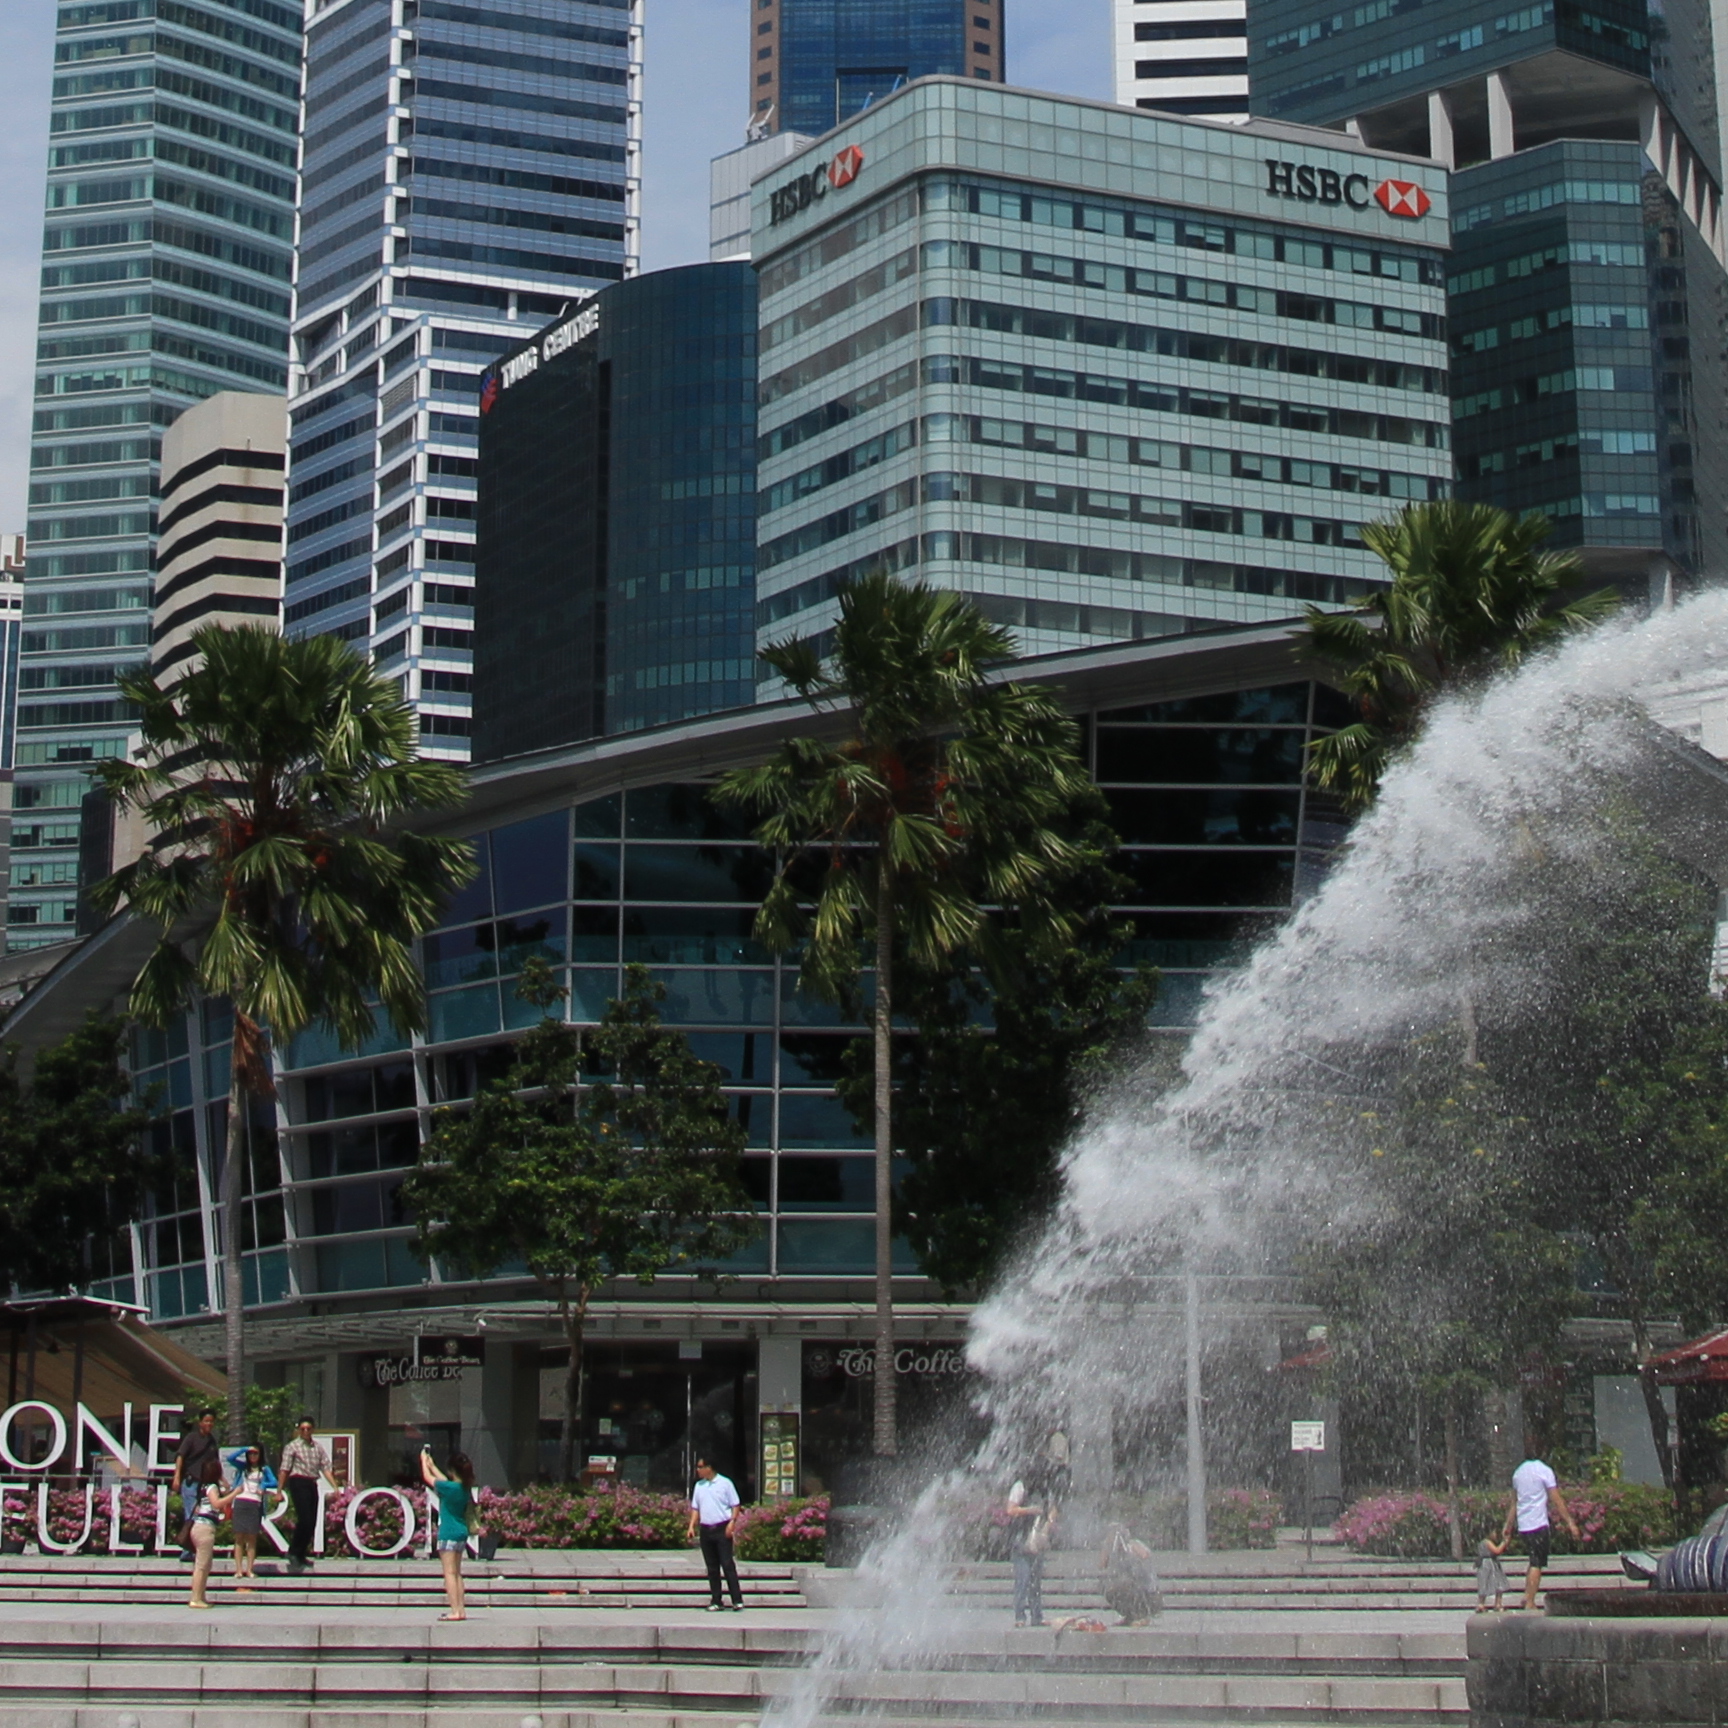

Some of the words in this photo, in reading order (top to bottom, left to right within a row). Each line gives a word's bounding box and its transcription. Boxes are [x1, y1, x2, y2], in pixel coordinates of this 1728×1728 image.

[770, 161, 828, 226] HSBC
[1265, 159, 1370, 209] HSBC
[500, 346, 538, 389] TUNG
[542, 303, 599, 361] CENTRE
[375, 1358, 398, 1385] The
[839, 1349, 875, 1377] Th
[894, 1348, 977, 1373] Coffe
